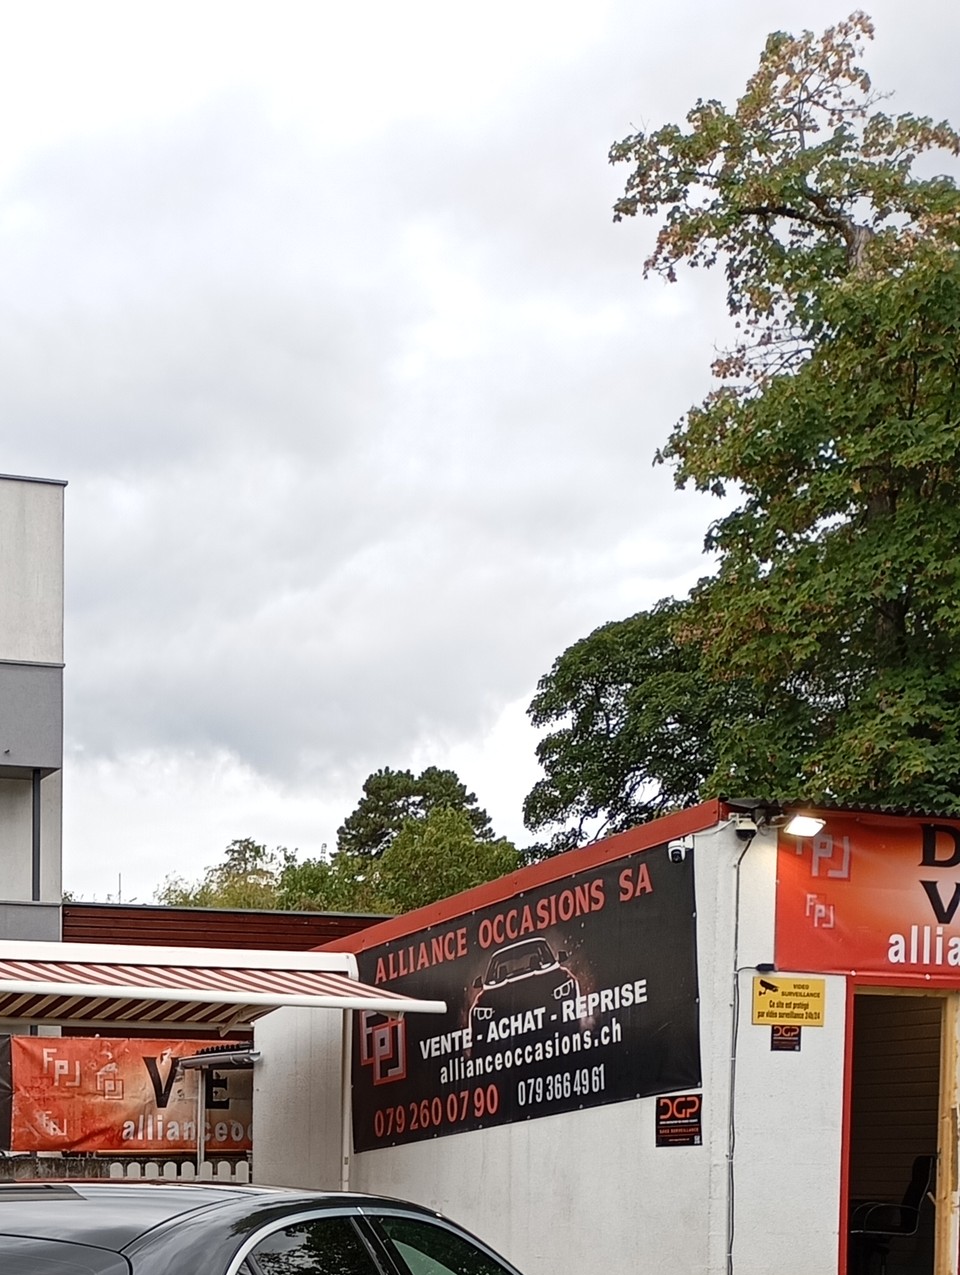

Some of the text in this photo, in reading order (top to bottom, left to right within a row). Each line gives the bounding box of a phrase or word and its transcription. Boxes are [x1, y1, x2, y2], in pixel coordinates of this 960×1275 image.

[375, 863, 654, 985] ALLIANCE OCCASIONS SA
[420, 1027, 473, 1060] VENTE
[486, 1006, 546, 1044] ACHAT
[562, 979, 648, 1023] REPRISE
[440, 1017, 622, 1084] allianceoccasions.ch
[374, 1083, 499, 1137] 079 260 07 90
[517, 1063, 605, 1106] 079 366 49 61
